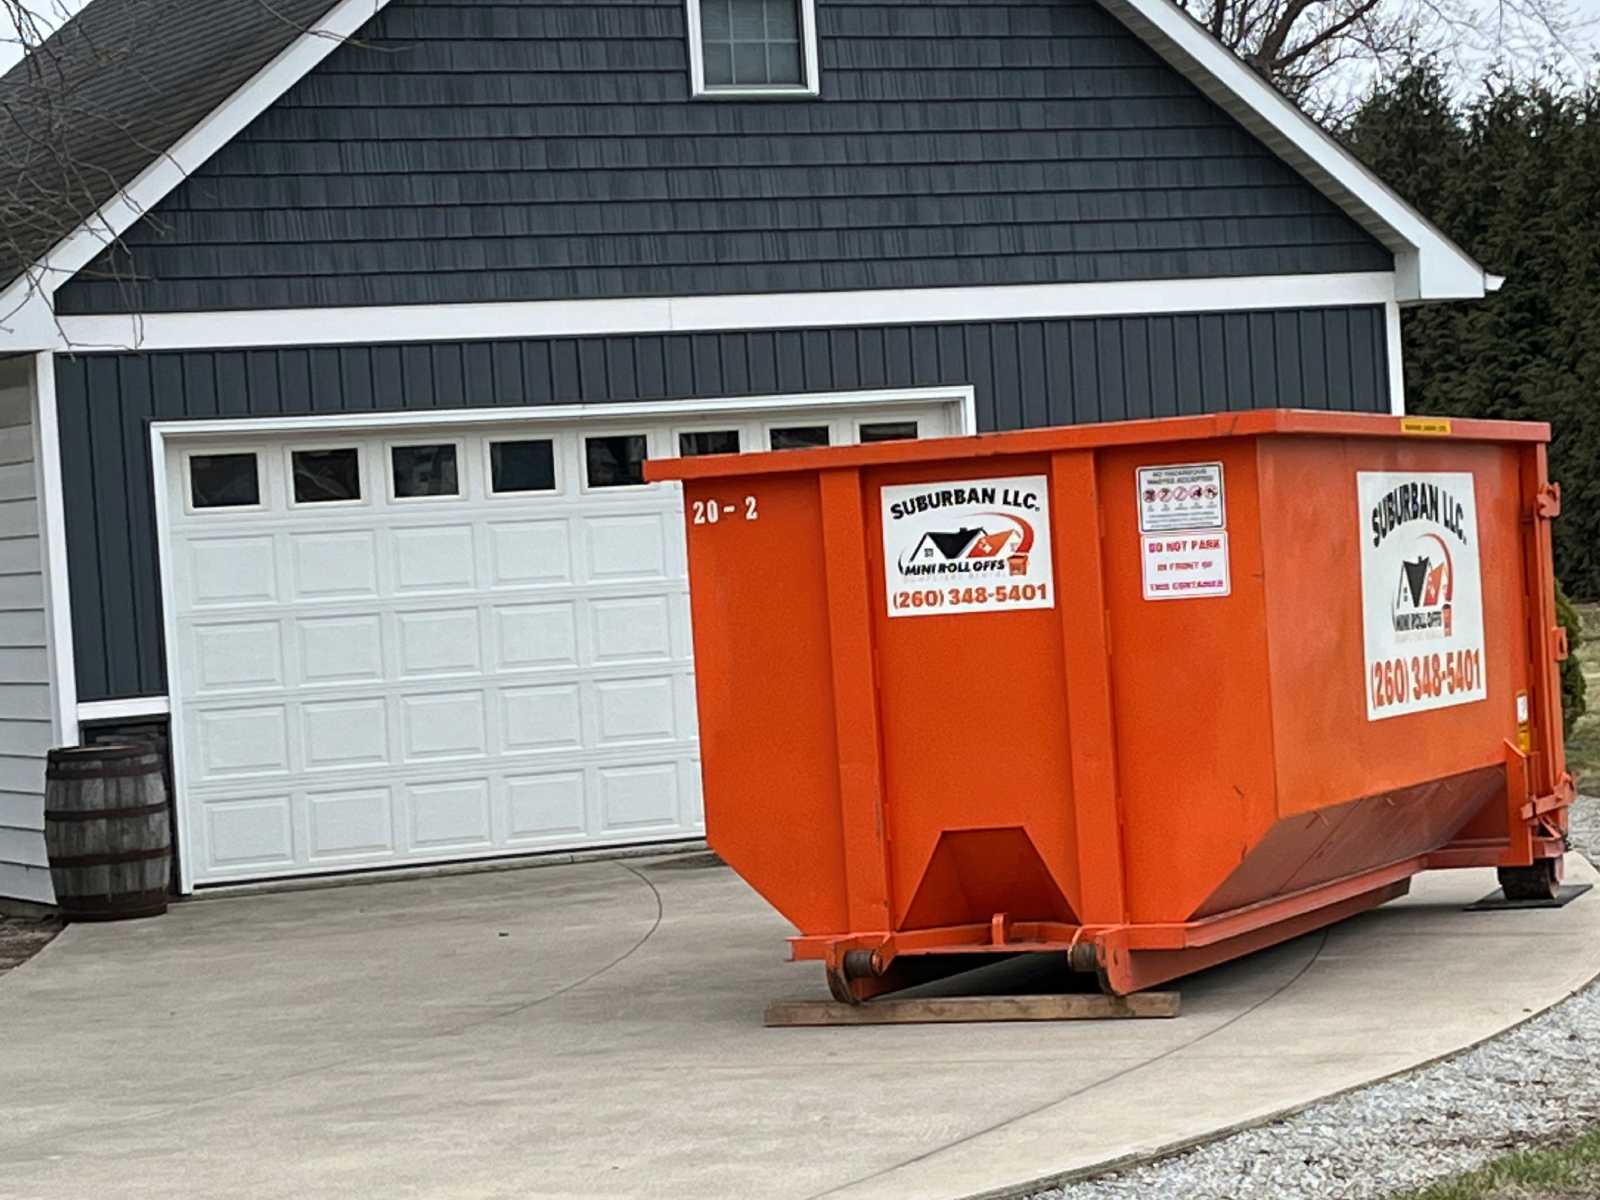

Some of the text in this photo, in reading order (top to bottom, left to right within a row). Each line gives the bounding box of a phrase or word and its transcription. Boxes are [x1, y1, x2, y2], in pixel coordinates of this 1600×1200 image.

[890, 487, 1041, 520] SUBURBAN LLC.
[1371, 482, 1439, 548] SUBURBAN
[1166, 540, 1188, 552] NOT
[1191, 539, 1220, 550] PARK
[904, 559, 1005, 577] MINI ROLL OFFS
[893, 584, 1047, 609] (260) 348-5401
[1370, 648, 1481, 712] (260) 348-5401
